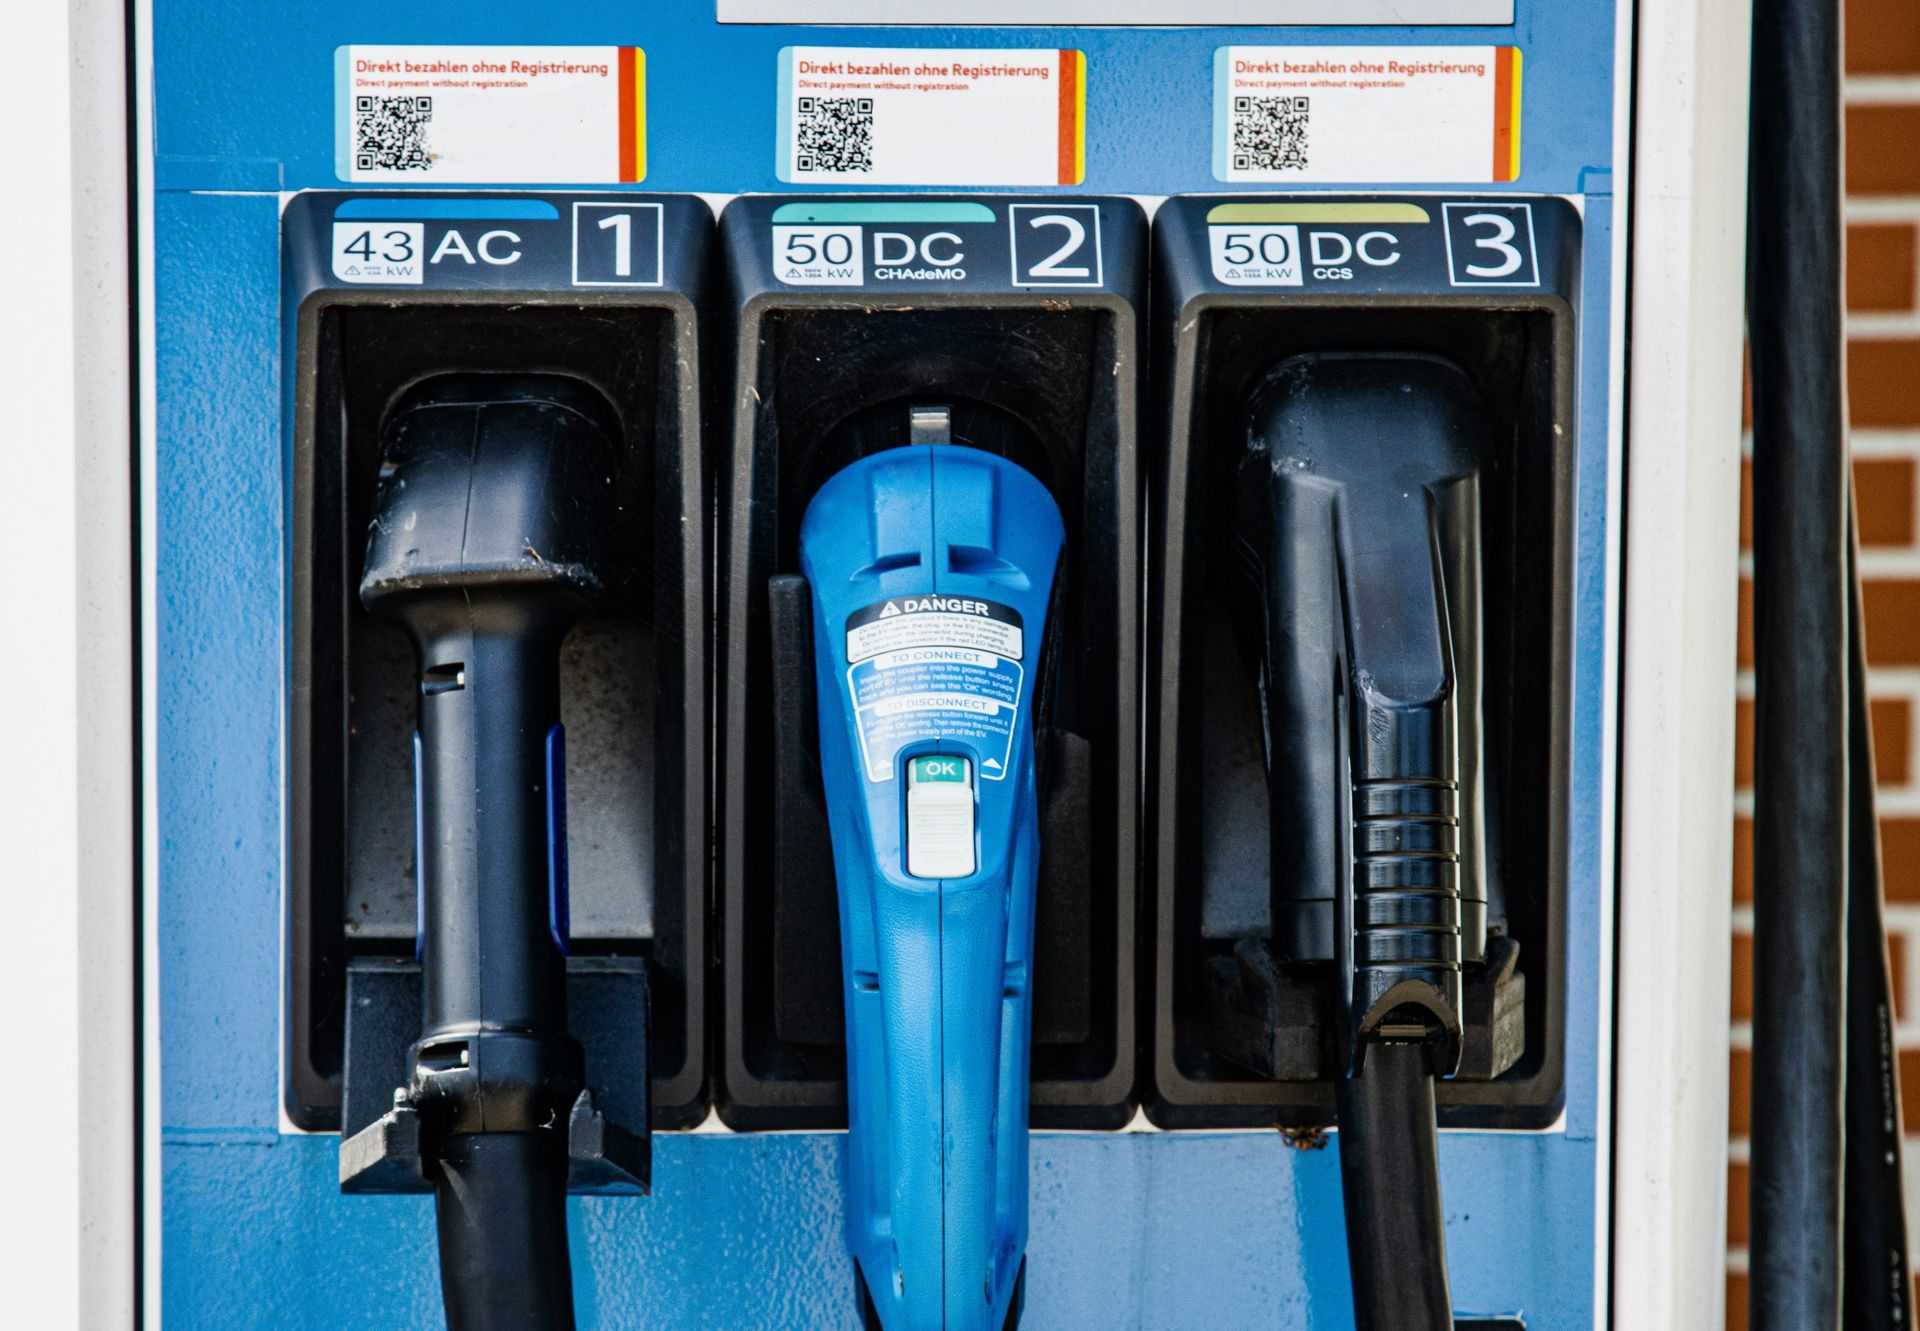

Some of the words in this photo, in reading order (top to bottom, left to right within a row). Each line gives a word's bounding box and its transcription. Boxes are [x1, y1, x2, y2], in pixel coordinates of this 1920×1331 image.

[356, 60, 401, 73] Direkt
[405, 60, 468, 73] bezahlen
[472, 60, 507, 73] ohne
[511, 60, 608, 77] Registrierung
[799, 61, 844, 75] Direkt
[847, 61, 910, 76] bezahlen
[914, 63, 949, 76] ohne
[952, 64, 1049, 79] Registrierung
[1235, 60, 1279, 73] Direkt
[1283, 60, 1346, 74] bezahlen
[1350, 61, 1384, 74] ohne
[1388, 60, 1485, 77] Registrierung
[356, 79, 385, 88] Direct
[387, 79, 429, 89] payment
[432, 79, 468, 88] without
[471, 79, 529, 89] registration
[798, 80, 827, 89] Direct
[830, 80, 871, 91] payment
[873, 81, 910, 90] without
[913, 82, 969, 91] registration
[1235, 79, 1263, 88] Direct
[1265, 79, 1307, 90] payment
[1310, 80, 1346, 88] without
[1349, 80, 1405, 89] registration
[343, 230, 414, 262] 43
[430, 229, 522, 265] AC
[597, 213, 632, 276] 1
[785, 233, 853, 265] 50
[874, 232, 965, 267] DC
[1028, 215, 1090, 277] 2
[1224, 233, 1290, 265] 50
[1309, 231, 1401, 267] DC
[1463, 213, 1523, 278] 3
[387, 266, 413, 276] kW
[827, 268, 854, 278] kW
[874, 268, 966, 281] CHAdeMO
[1266, 268, 1293, 278] kW
[1312, 267, 1354, 280] CCS
[904, 598, 989, 616] DANGER
[891, 653, 909, 663] TO
[914, 650, 981, 663] CONNECT
[929, 664, 945, 672] into
[946, 664, 960, 672] the
[962, 666, 987, 676] power
[988, 671, 1013, 684] supply
[930, 682, 946, 690] see
[947, 682, 962, 690] the
[933, 673, 963, 681] release
[965, 674, 990, 685] button
[992, 680, 1015, 693] snaps
[906, 697, 987, 710] DISCONNECT
[941, 728, 955, 736] port
[964, 729, 976, 737] the
[926, 759, 957, 776] OK
